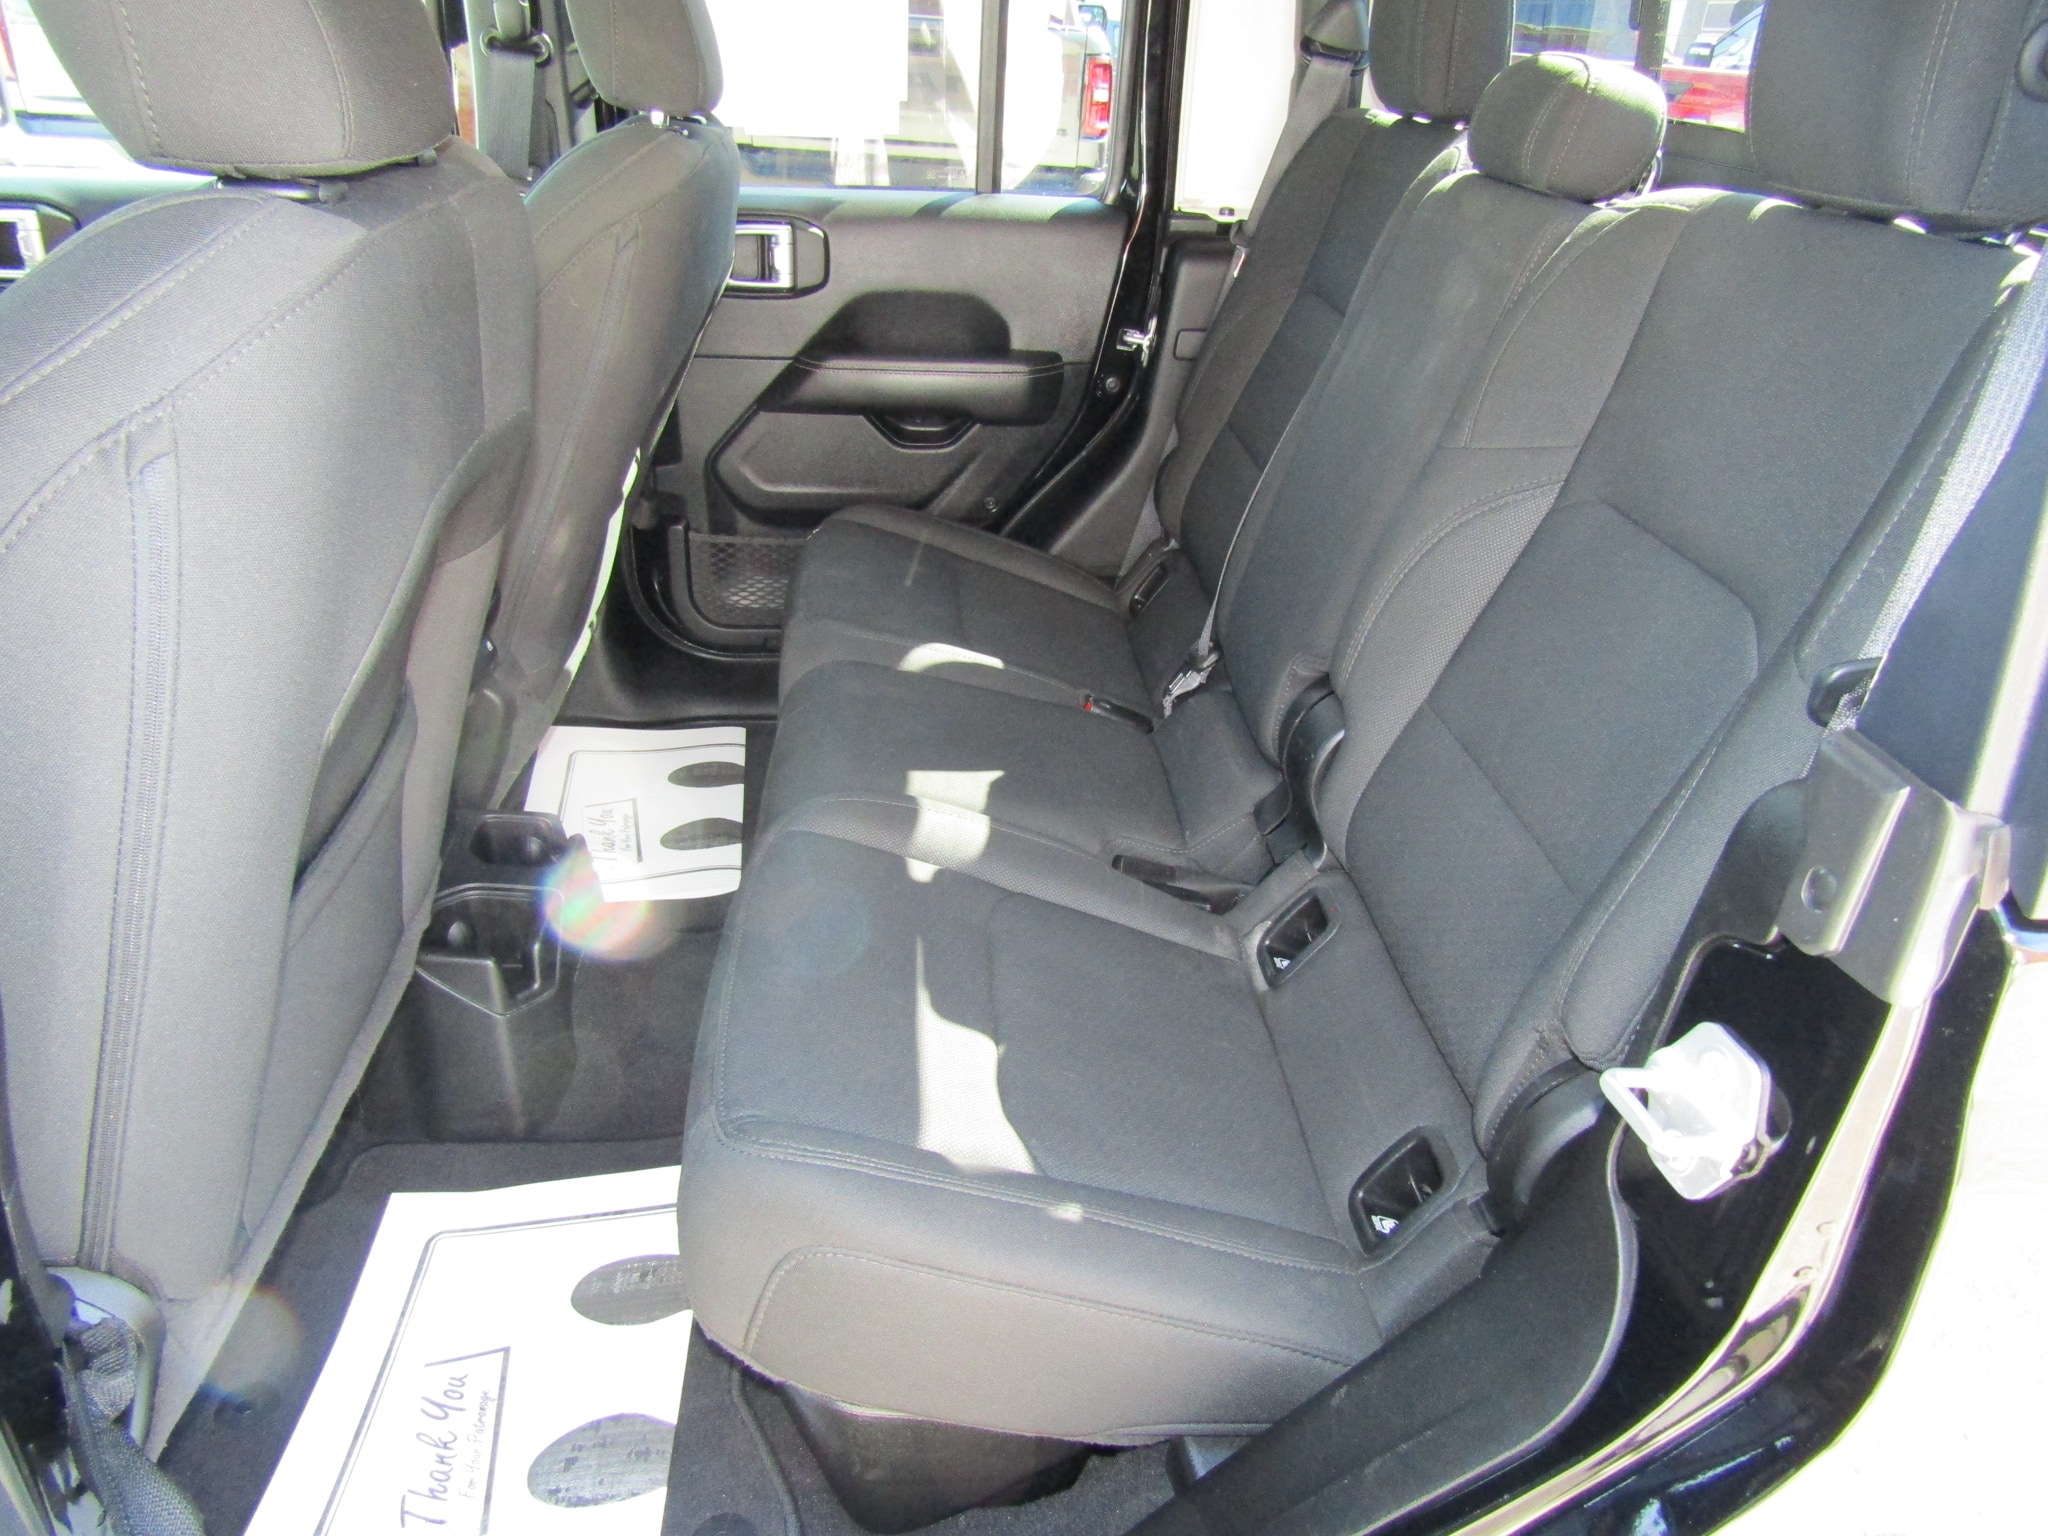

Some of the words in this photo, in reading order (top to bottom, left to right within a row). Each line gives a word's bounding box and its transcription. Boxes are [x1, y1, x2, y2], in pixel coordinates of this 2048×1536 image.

[421, 1375, 468, 1420] You
[468, 1389, 496, 1442] Patronage
[401, 1430, 458, 1528] Thank
[464, 1448, 481, 1471] Your
[458, 1479, 476, 1498] For
